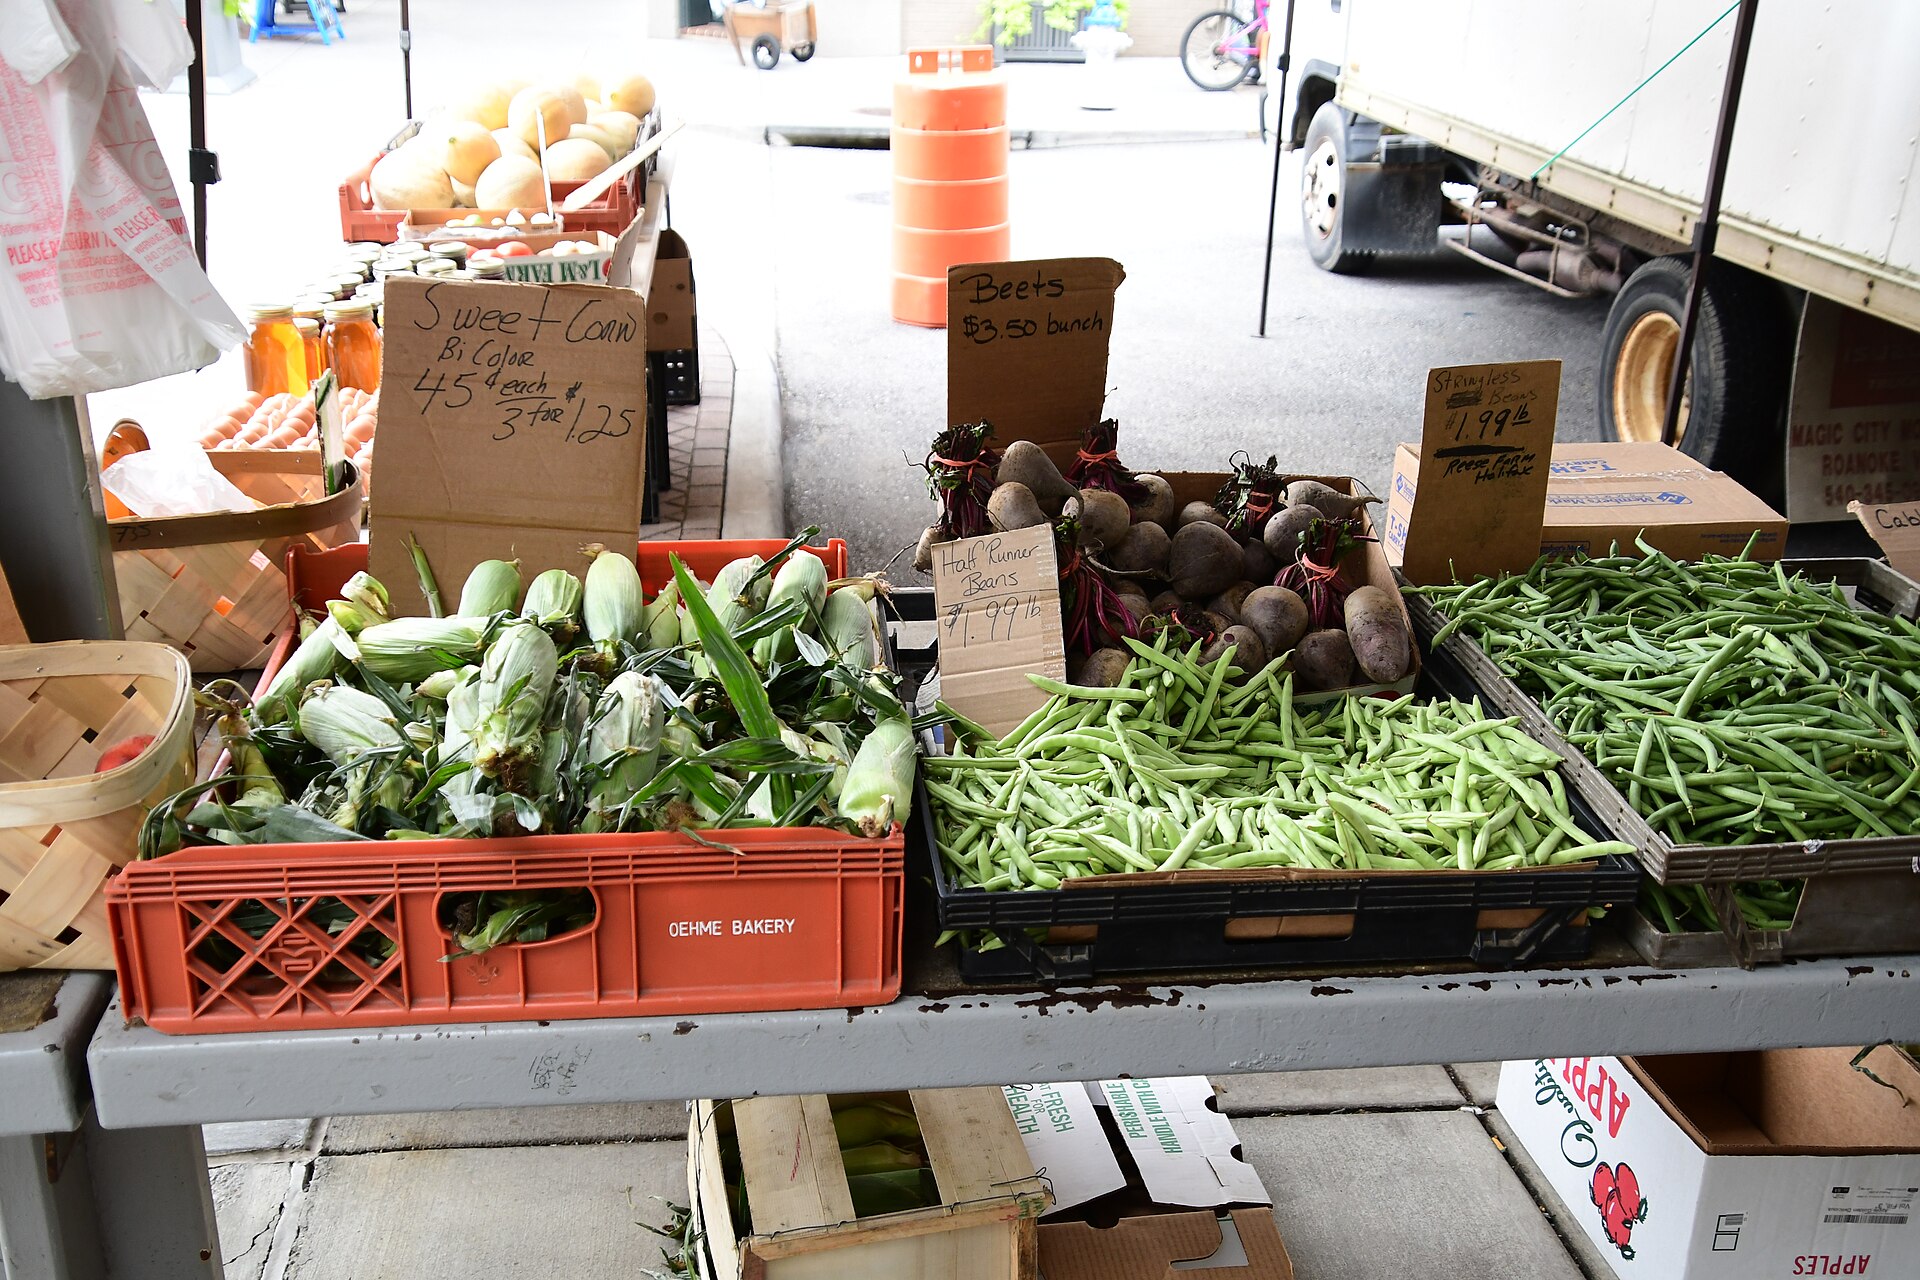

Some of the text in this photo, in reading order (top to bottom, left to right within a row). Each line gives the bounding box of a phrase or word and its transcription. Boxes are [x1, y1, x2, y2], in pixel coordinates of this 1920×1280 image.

[113, 211, 154, 242] PLEASE
[7, 241, 48, 266] PLEASE
[557, 260, 601, 282] L&M
[960, 270, 1065, 304] Beets
[414, 282, 562, 341] Sweet
[963, 310, 1103, 344] $3.50 bunch
[437, 337, 466, 362] Bi
[500, 371, 548, 396] each
[492, 408, 523, 441] 3
[1791, 422, 1844, 447] MAGIC
[1853, 420, 1891, 444] CITY
[1822, 452, 1900, 476] ROANOKE
[942, 537, 1040, 577] Half Runner
[961, 571, 1019, 597] Beans
[668, 918, 796, 938] OEHME BAKERY
[1004, 1087, 1040, 1135] HEALTH
[1031, 1098, 1046, 1115] FOR
[1041, 1091, 1075, 1133] FRESH
[1106, 1082, 1148, 1138] PERISHABLE
[1136, 1090, 1164, 1115] WITH
[1148, 1116, 1184, 1154] HANDLE
[1792, 1254, 1872, 1276] APPLES
